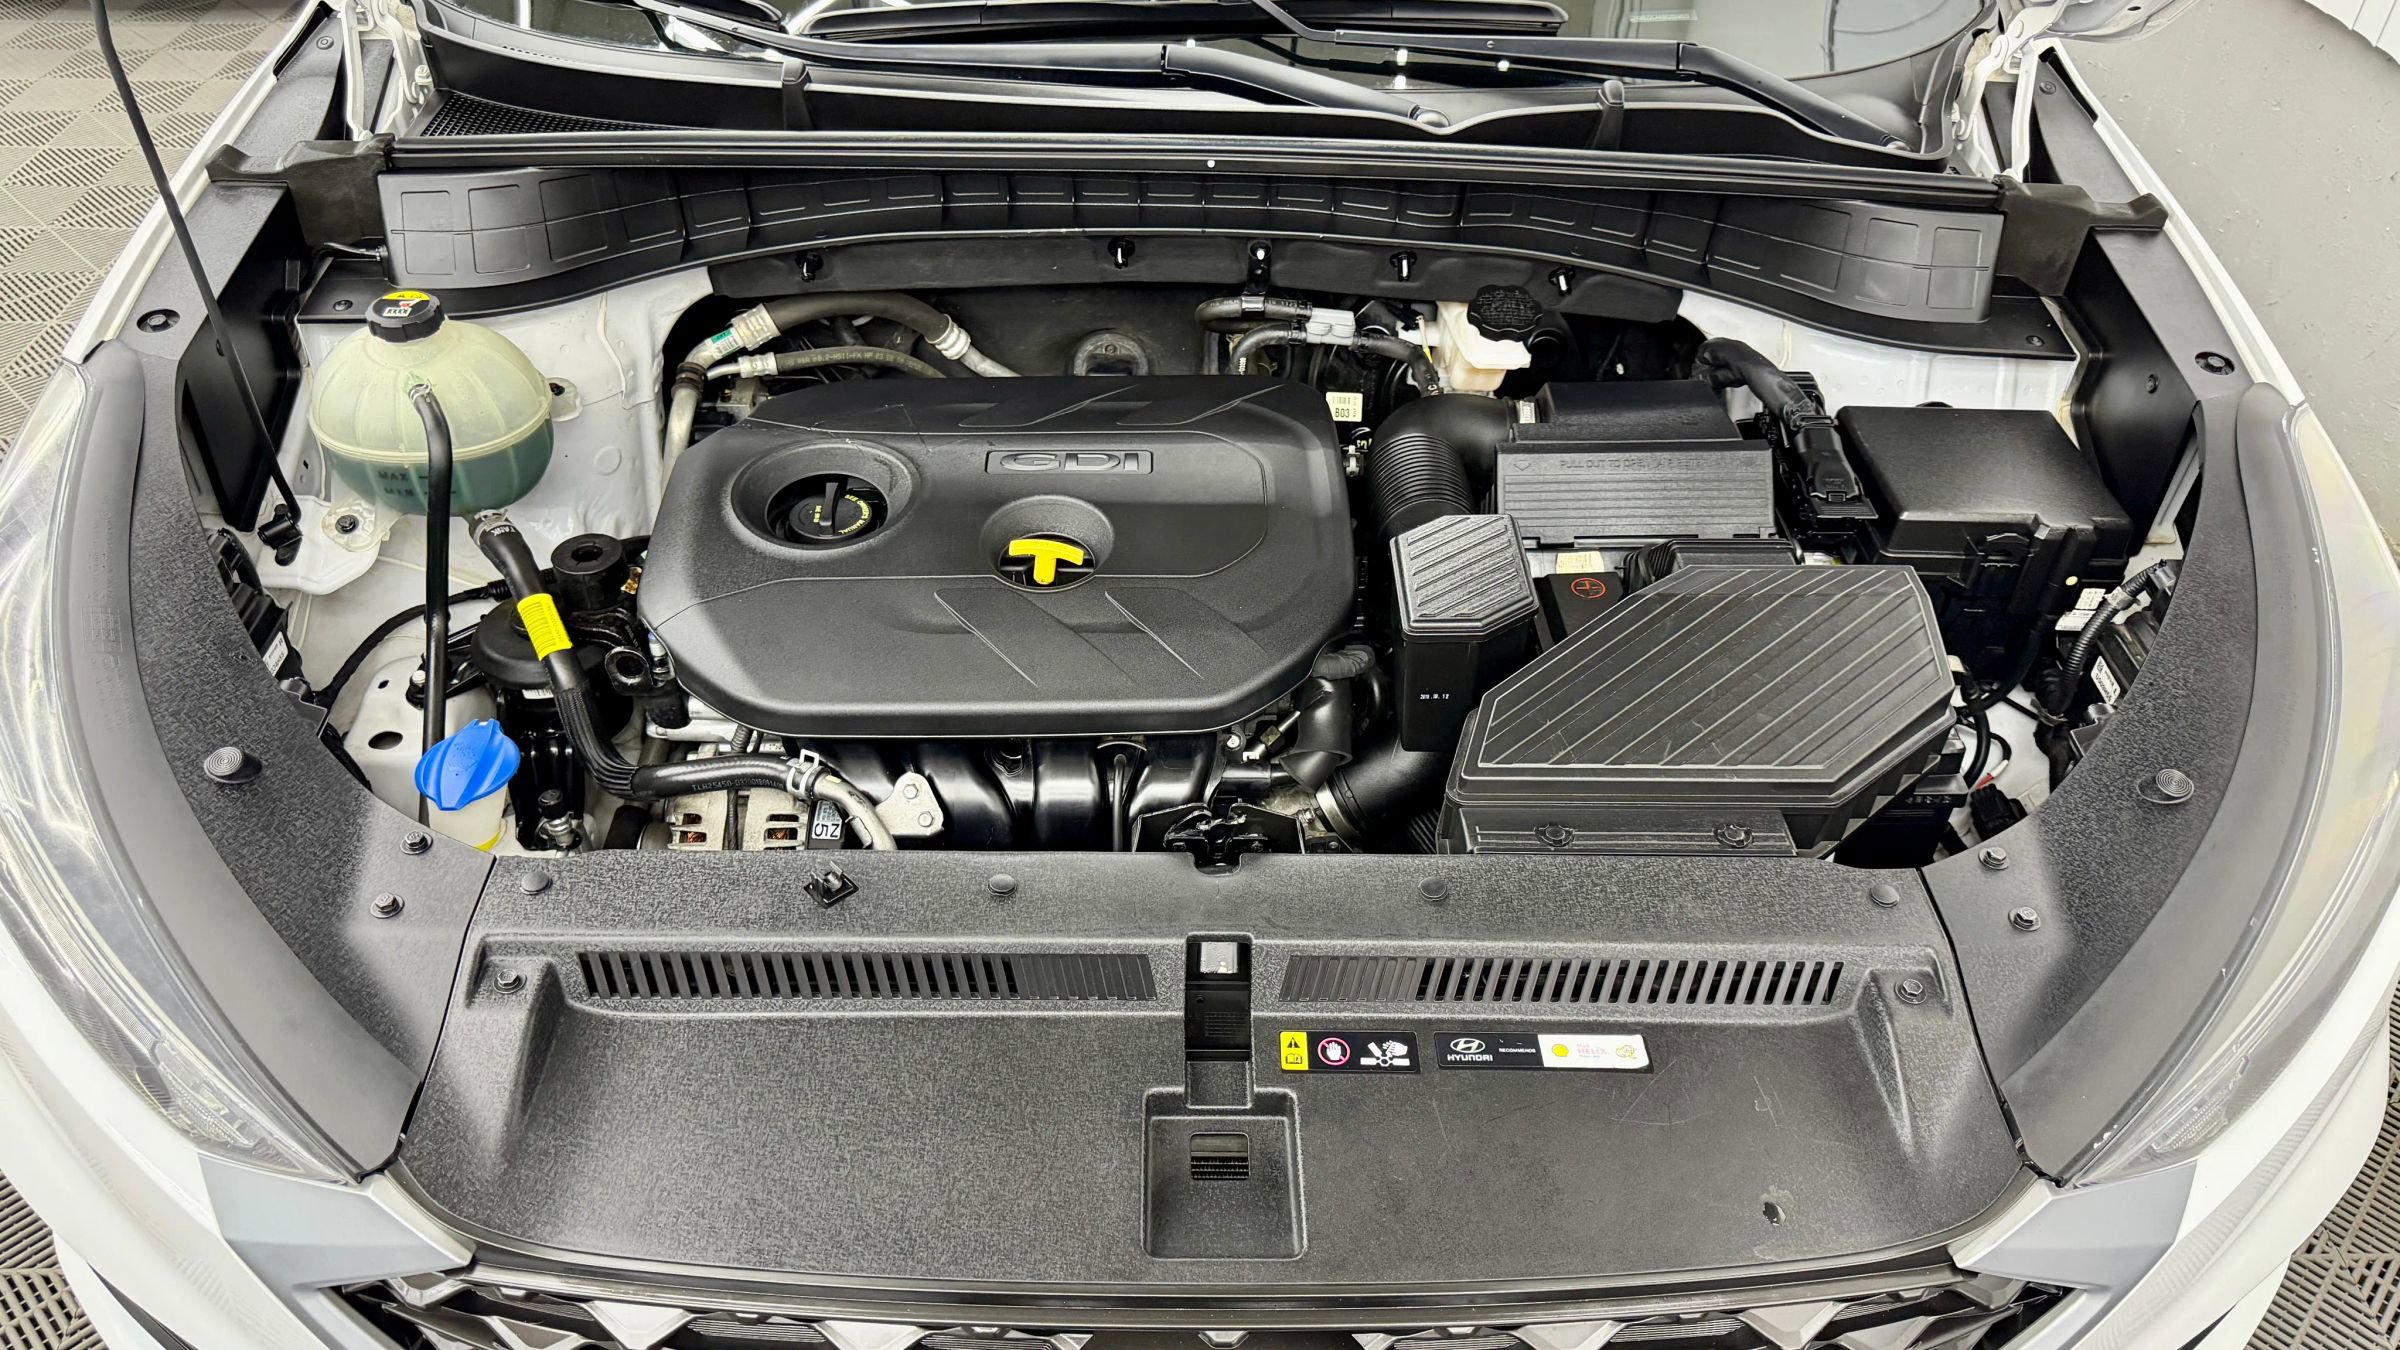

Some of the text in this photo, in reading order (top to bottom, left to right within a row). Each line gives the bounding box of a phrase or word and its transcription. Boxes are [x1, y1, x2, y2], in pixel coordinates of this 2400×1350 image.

[1000, 452, 1139, 471] GDI
[378, 471, 408, 481] MAX
[814, 823, 829, 838] 5
[829, 823, 841, 838] N
[1447, 1053, 1493, 1062] HYUNDAI
